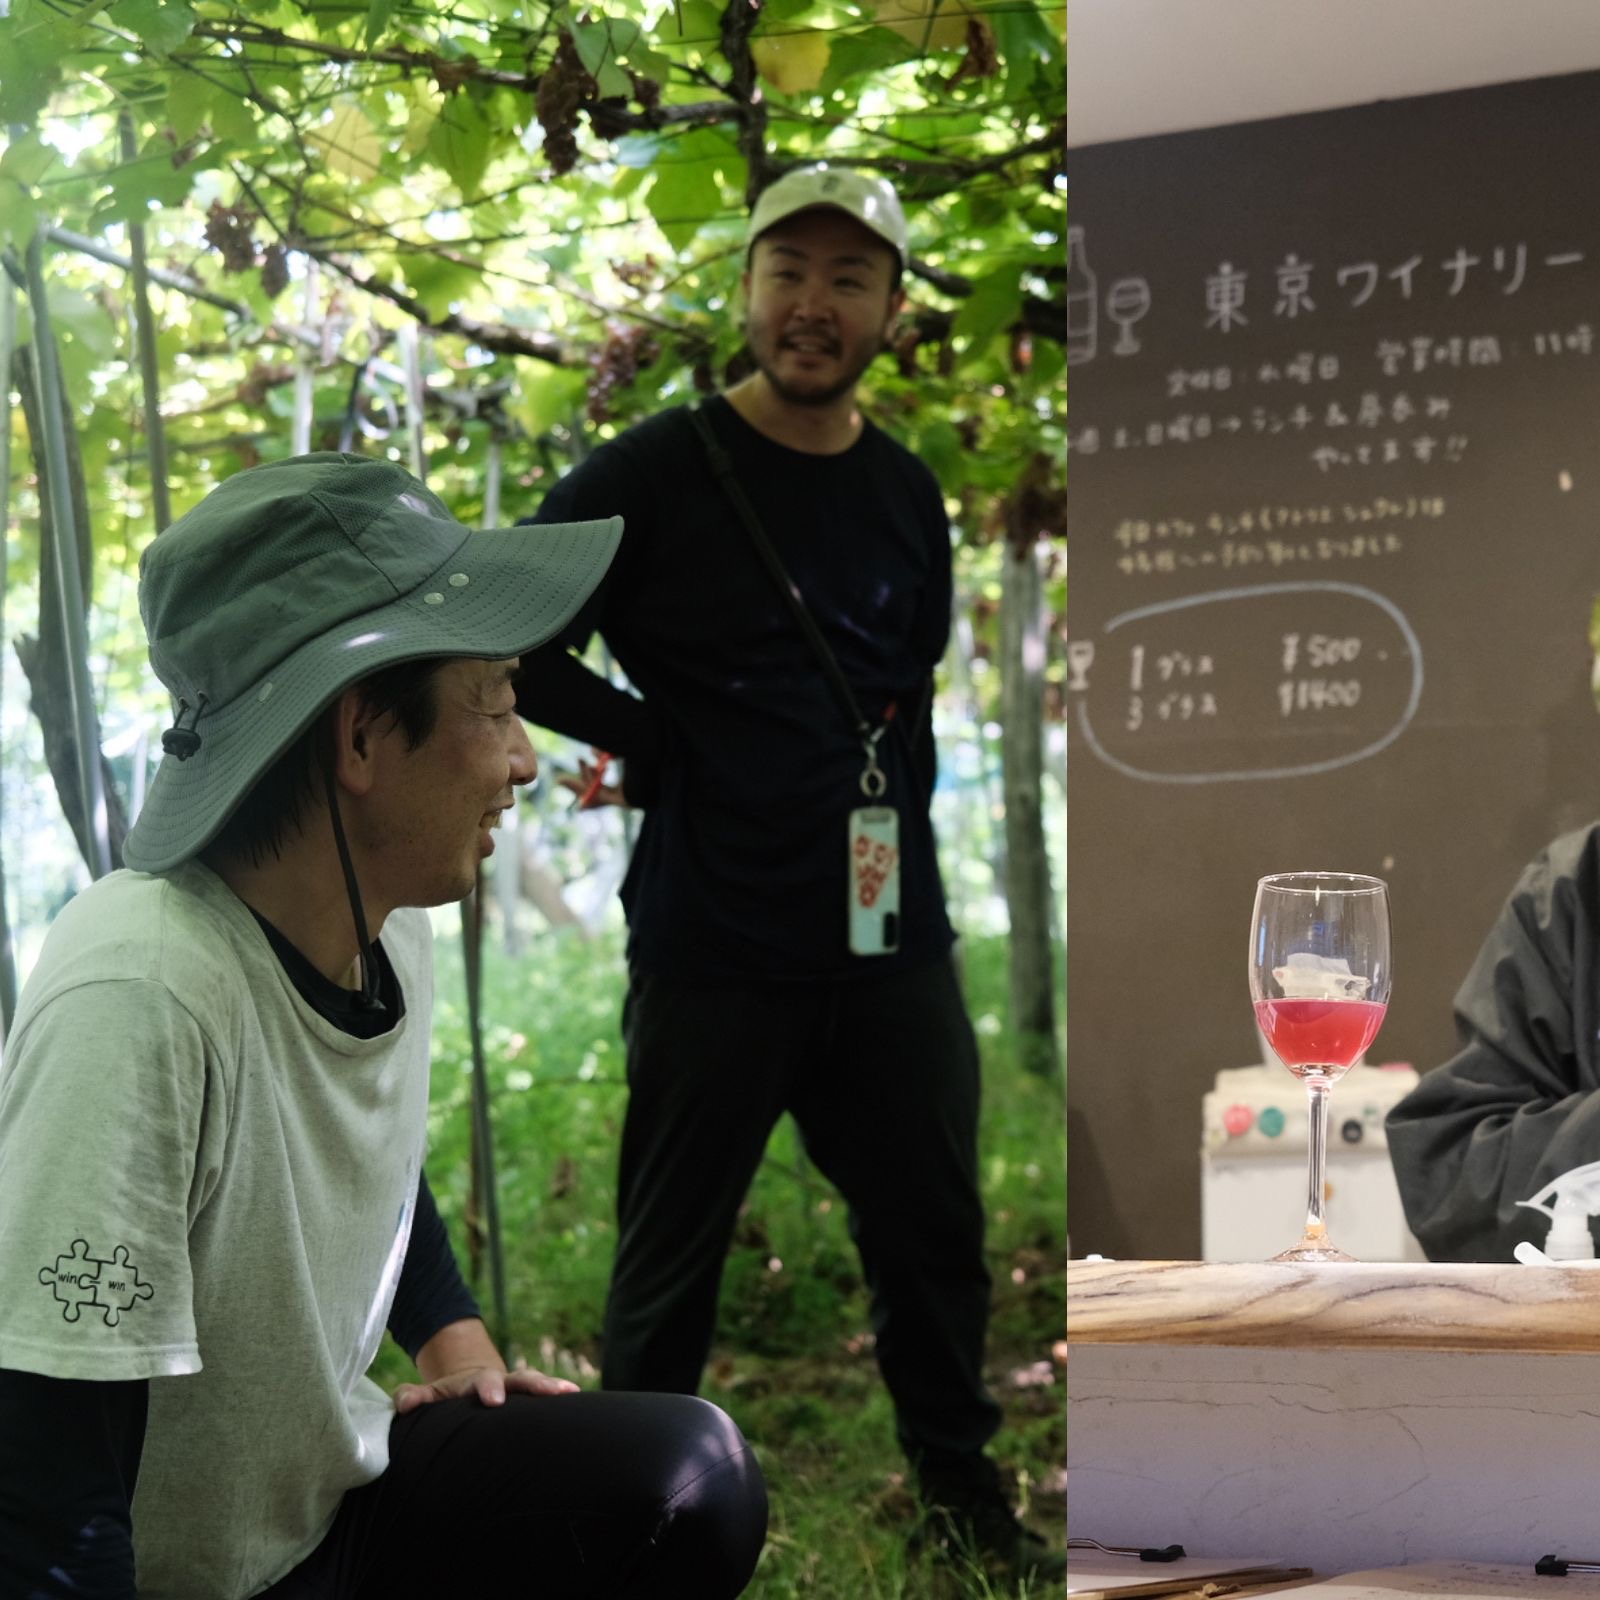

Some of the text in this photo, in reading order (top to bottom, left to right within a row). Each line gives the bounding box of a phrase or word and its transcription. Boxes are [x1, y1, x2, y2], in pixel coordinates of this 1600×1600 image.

[1204, 242, 1586, 333] 東京ワイナリー
[57, 1272, 78, 1285] win
[108, 1279, 126, 1292] win
